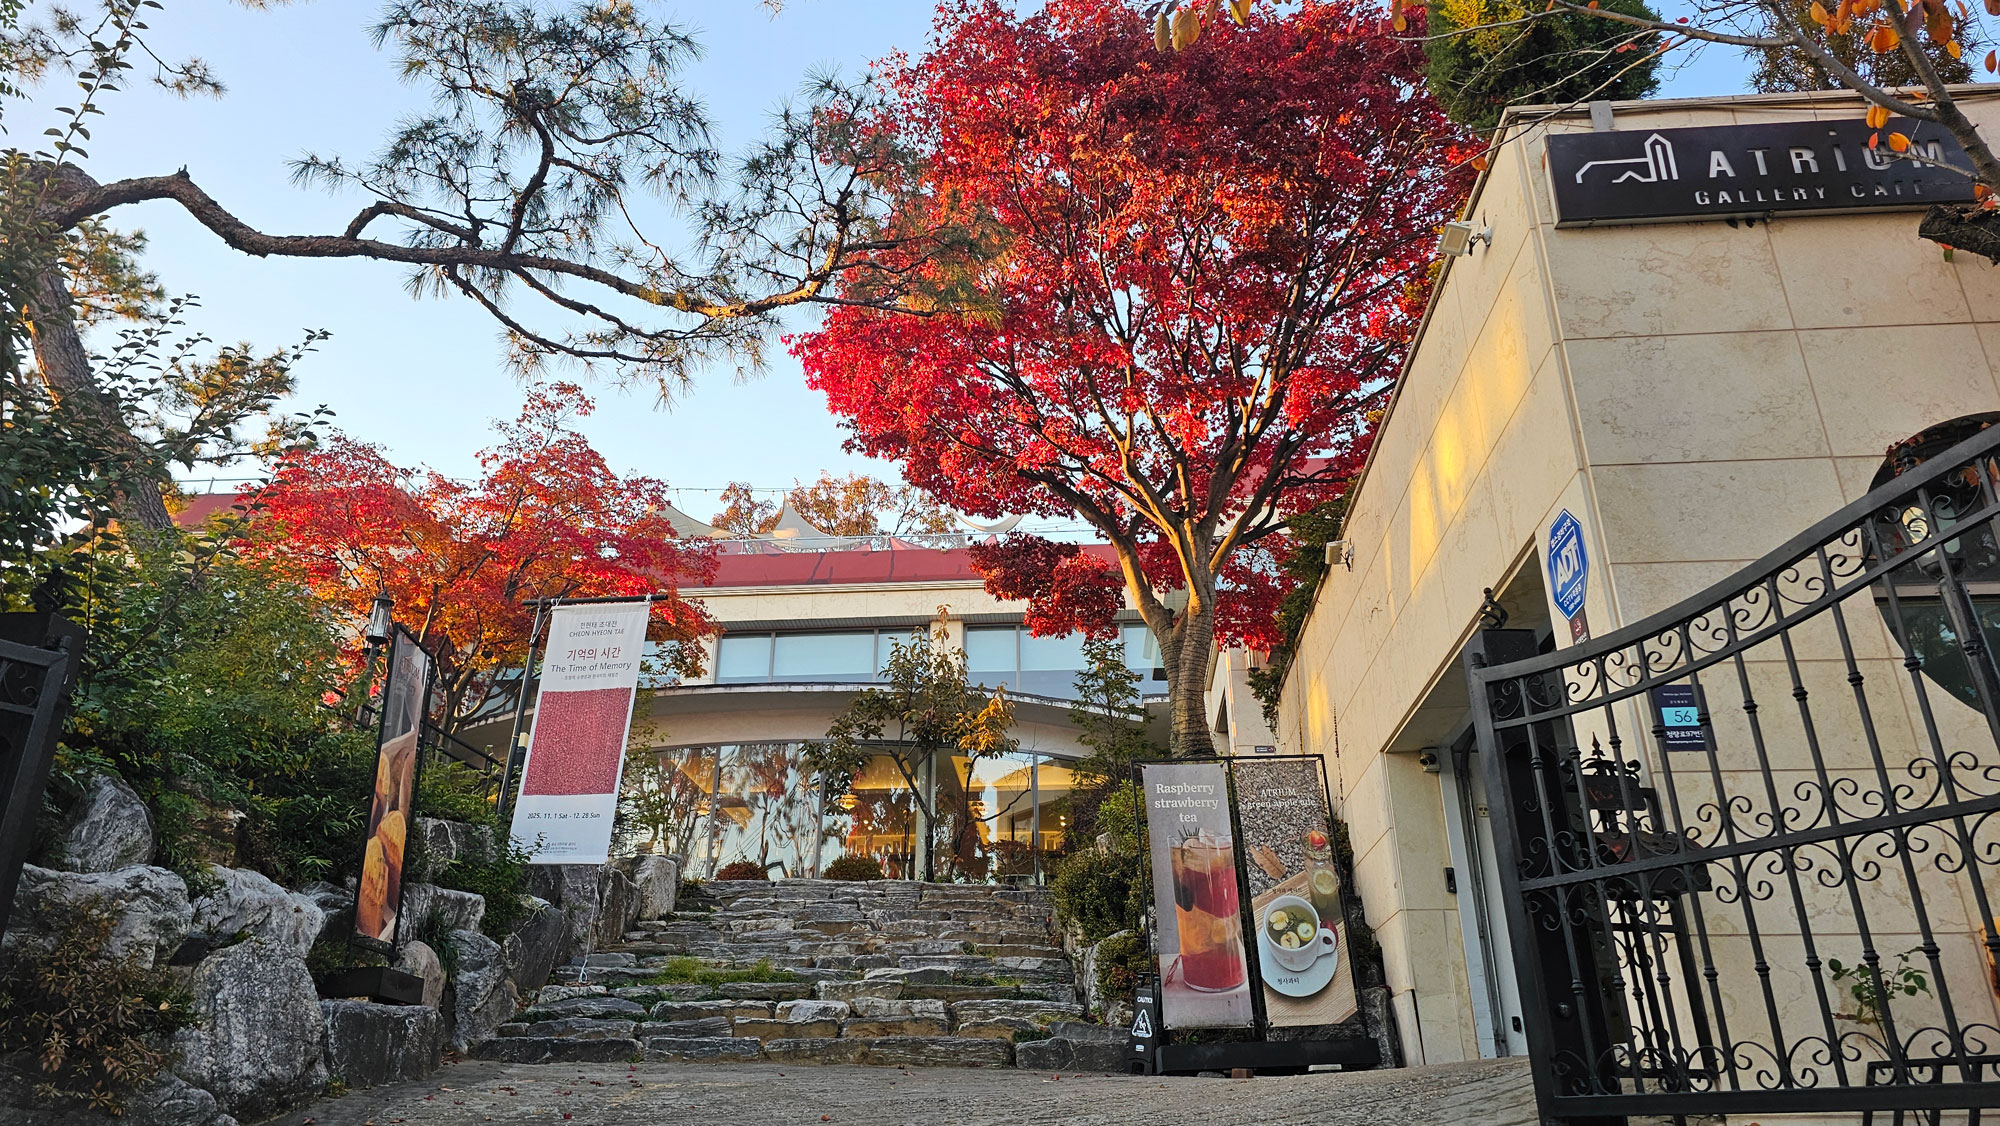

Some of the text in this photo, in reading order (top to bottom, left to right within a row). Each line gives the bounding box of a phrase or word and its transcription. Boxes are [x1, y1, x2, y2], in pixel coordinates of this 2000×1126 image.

[1694, 188, 1825, 205] GALLERY
[1557, 534, 1580, 594] ADT
[567, 646, 621, 661] 기억의 시간
[551, 662, 632, 673] The Time of Memory
[1674, 710, 1693, 723] 56
[1155, 782, 1215, 795] Raspberry
[1261, 788, 1296, 797] ATRIUM
[1154, 797, 1219, 810] strawberry
[1247, 797, 1316, 810] green apple ade
[590, 811, 601, 819] Sun
[1179, 812, 1198, 823] tea
